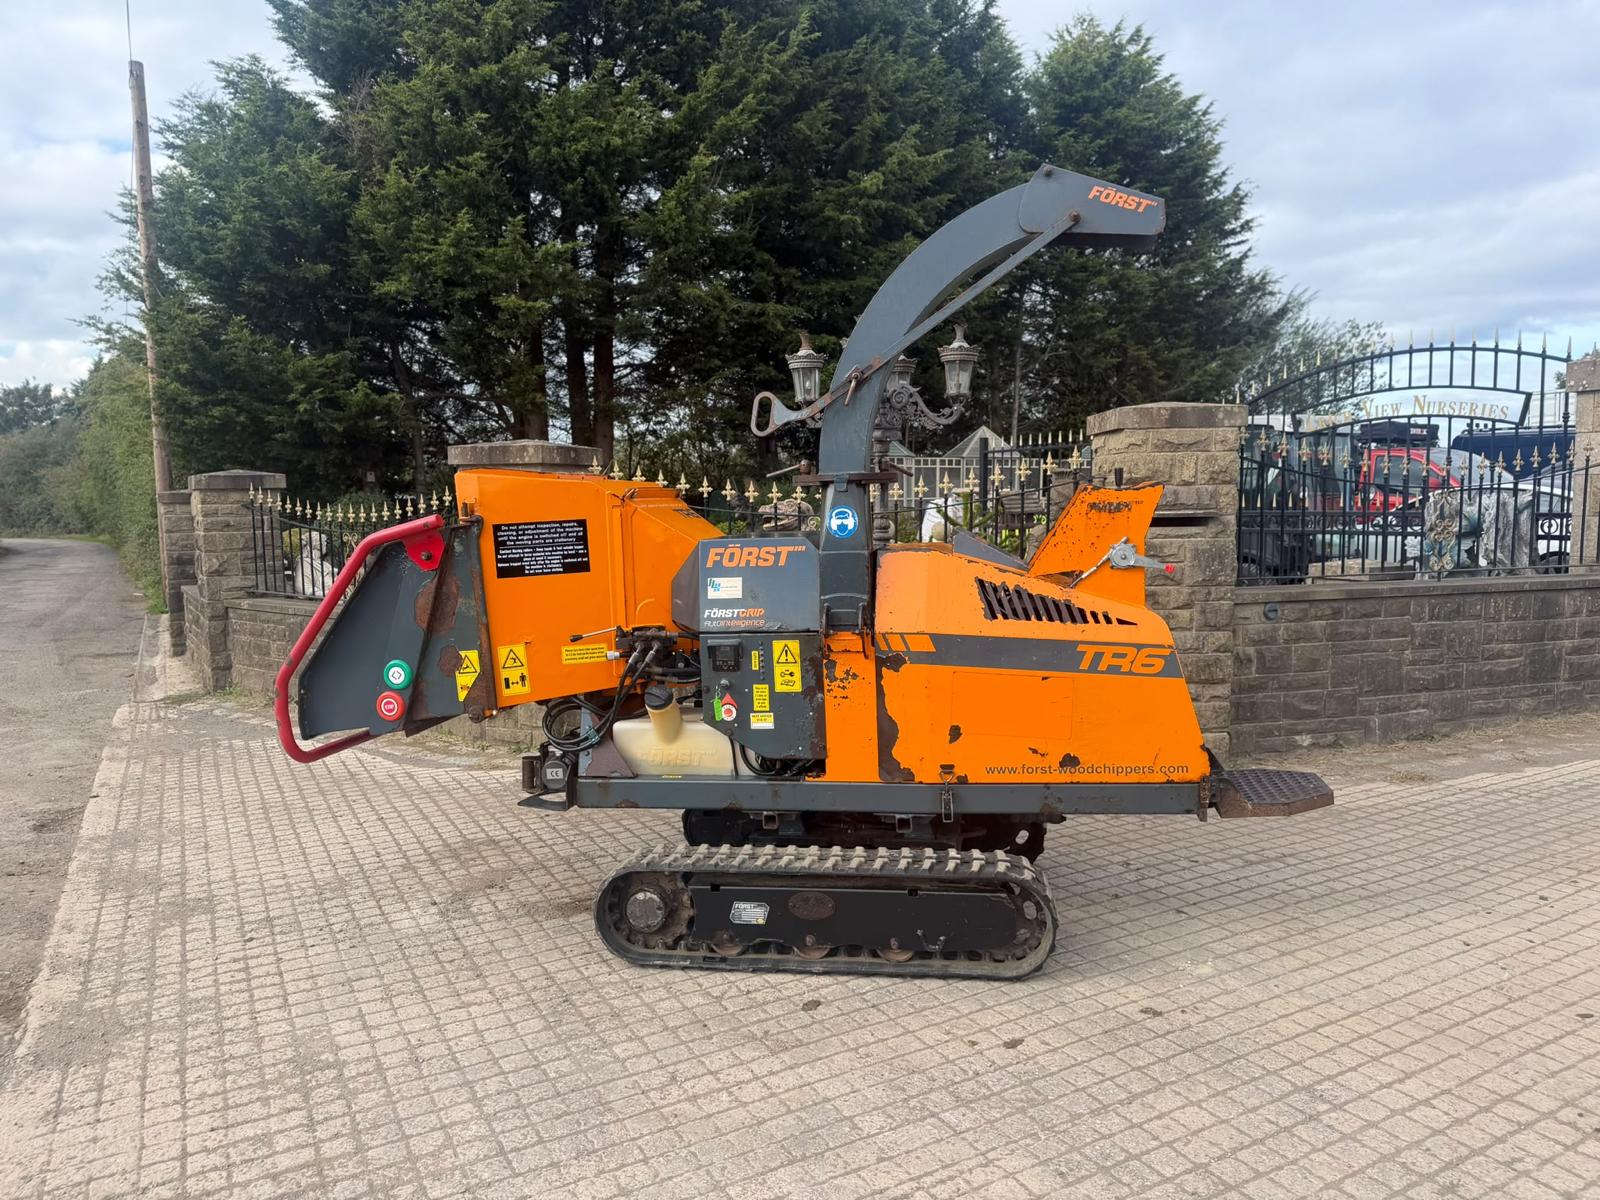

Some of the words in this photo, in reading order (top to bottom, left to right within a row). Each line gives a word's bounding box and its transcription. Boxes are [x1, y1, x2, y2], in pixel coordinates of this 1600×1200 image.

[706, 544, 792, 568] FÖRST
[1076, 644, 1171, 675] TR6
[985, 764, 1189, 777] www.forst-woodchippers.com
